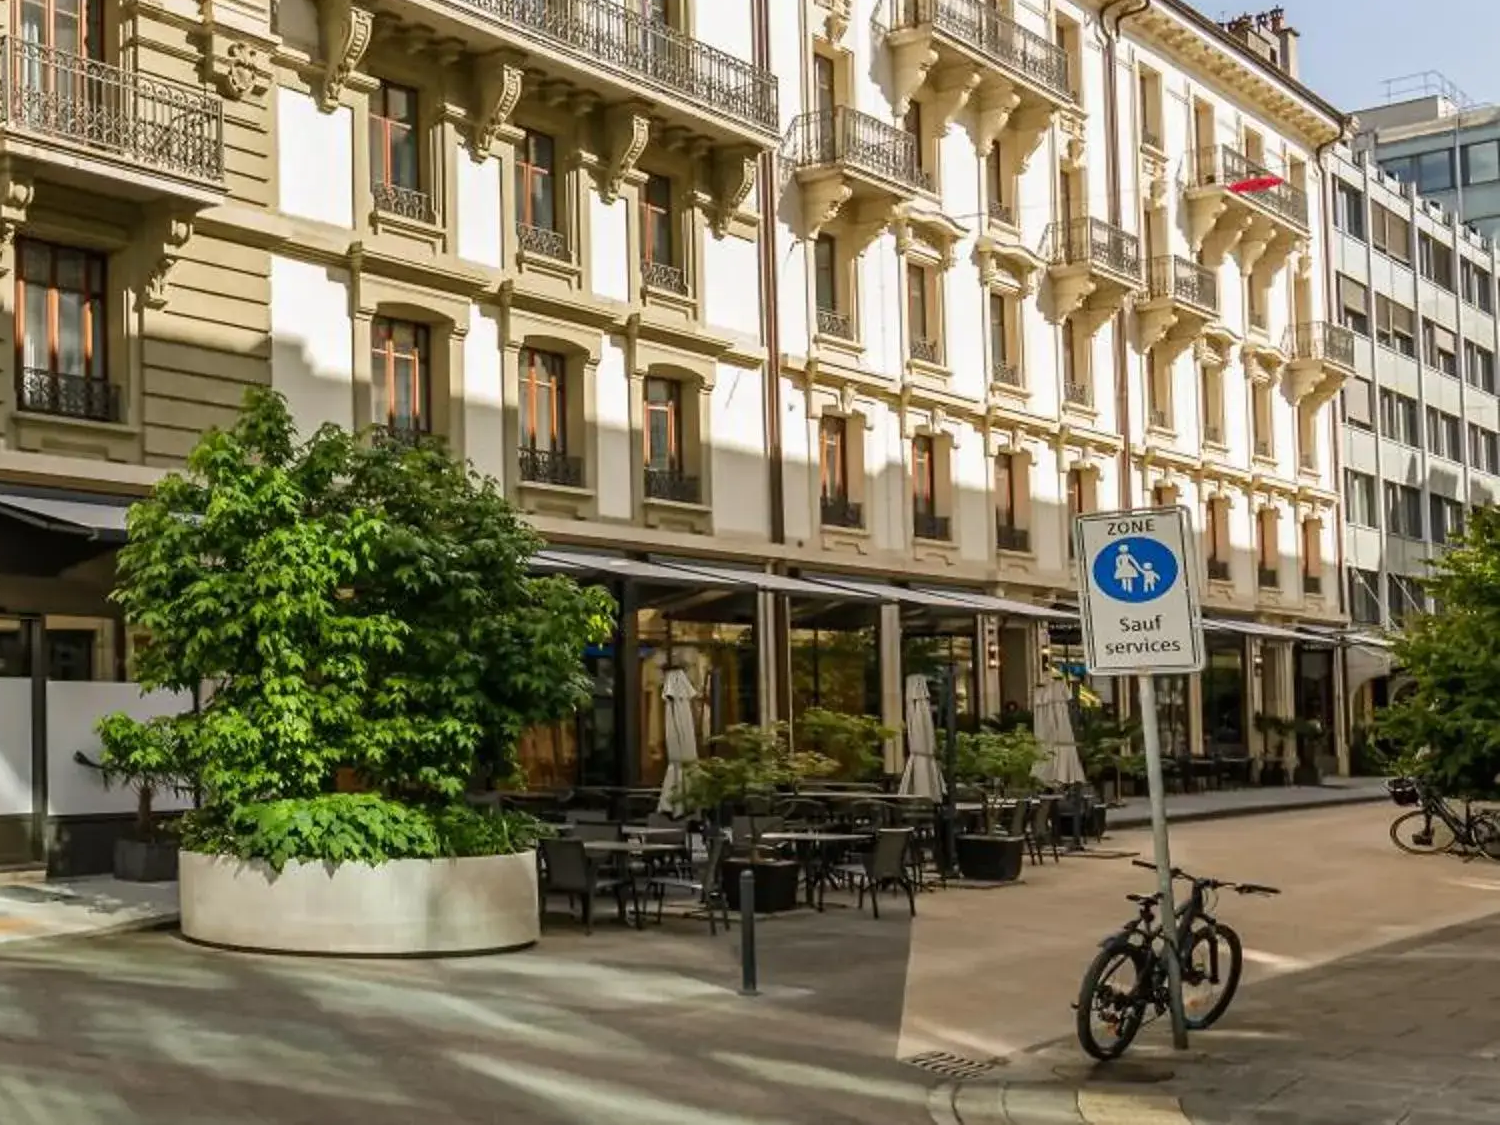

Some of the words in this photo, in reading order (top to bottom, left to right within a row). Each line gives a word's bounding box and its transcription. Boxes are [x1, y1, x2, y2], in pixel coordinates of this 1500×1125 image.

[1107, 518, 1156, 536] ZONE
[1119, 613, 1163, 632] Sauf
[1104, 638, 1181, 655] services
